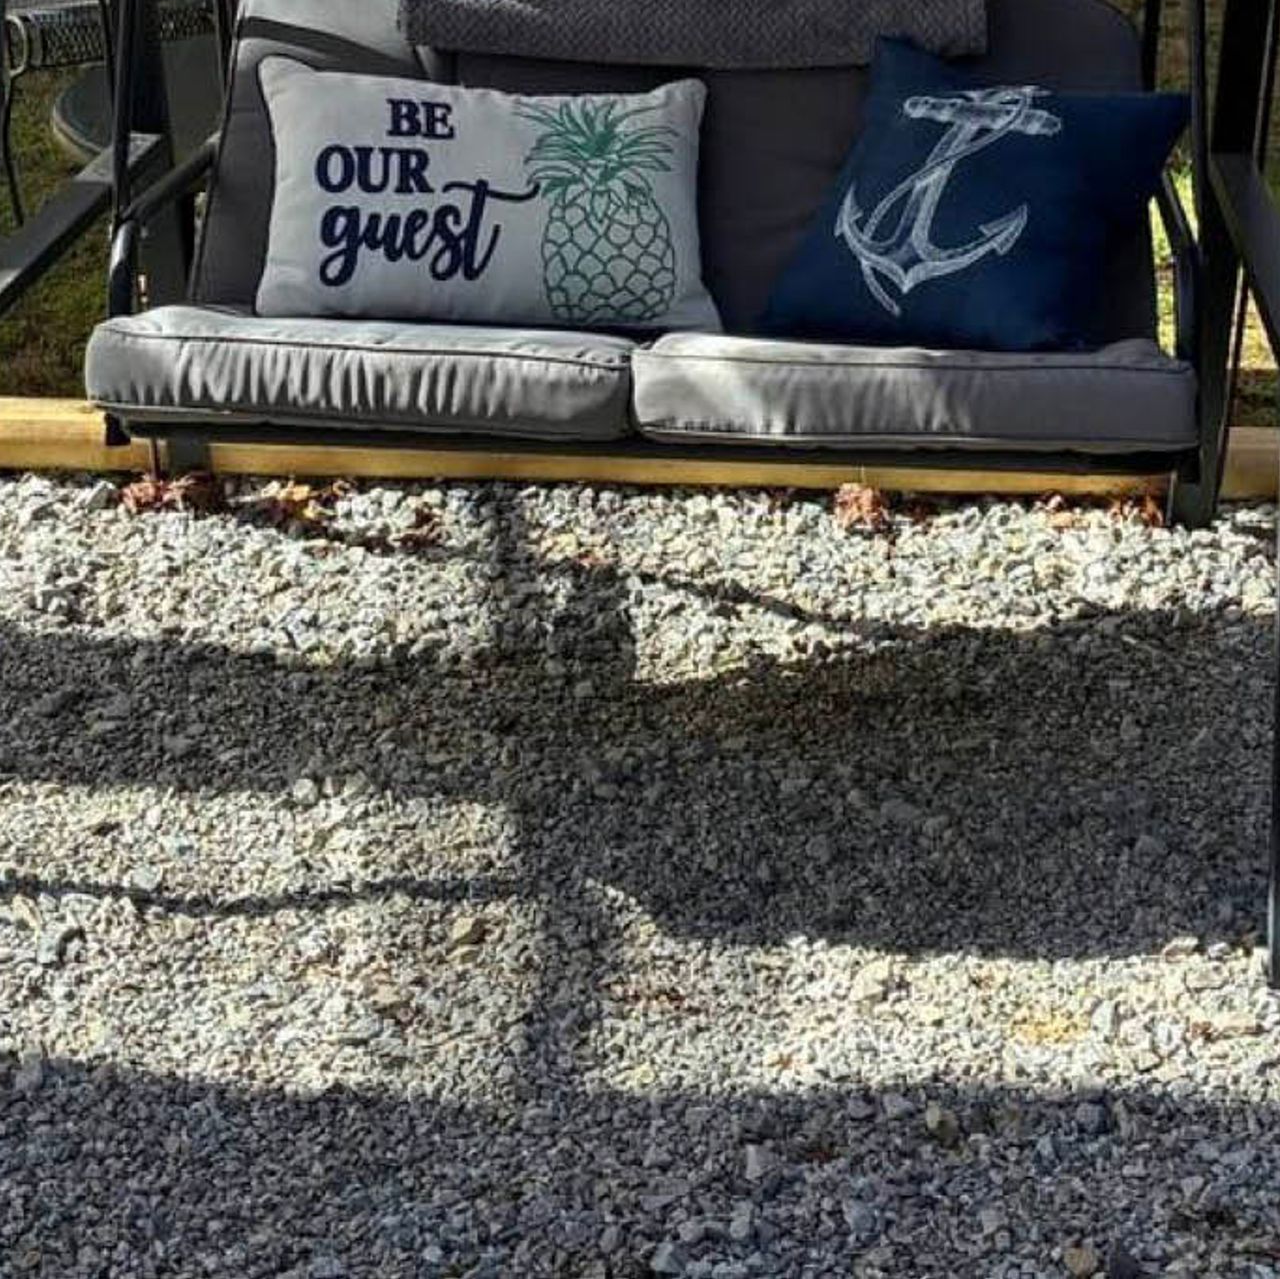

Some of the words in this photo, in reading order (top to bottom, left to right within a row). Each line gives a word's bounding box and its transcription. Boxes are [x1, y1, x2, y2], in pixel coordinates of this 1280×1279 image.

[386, 98, 455, 140] BE
[316, 144, 435, 194] OUR
[319, 179, 540, 287] guest
